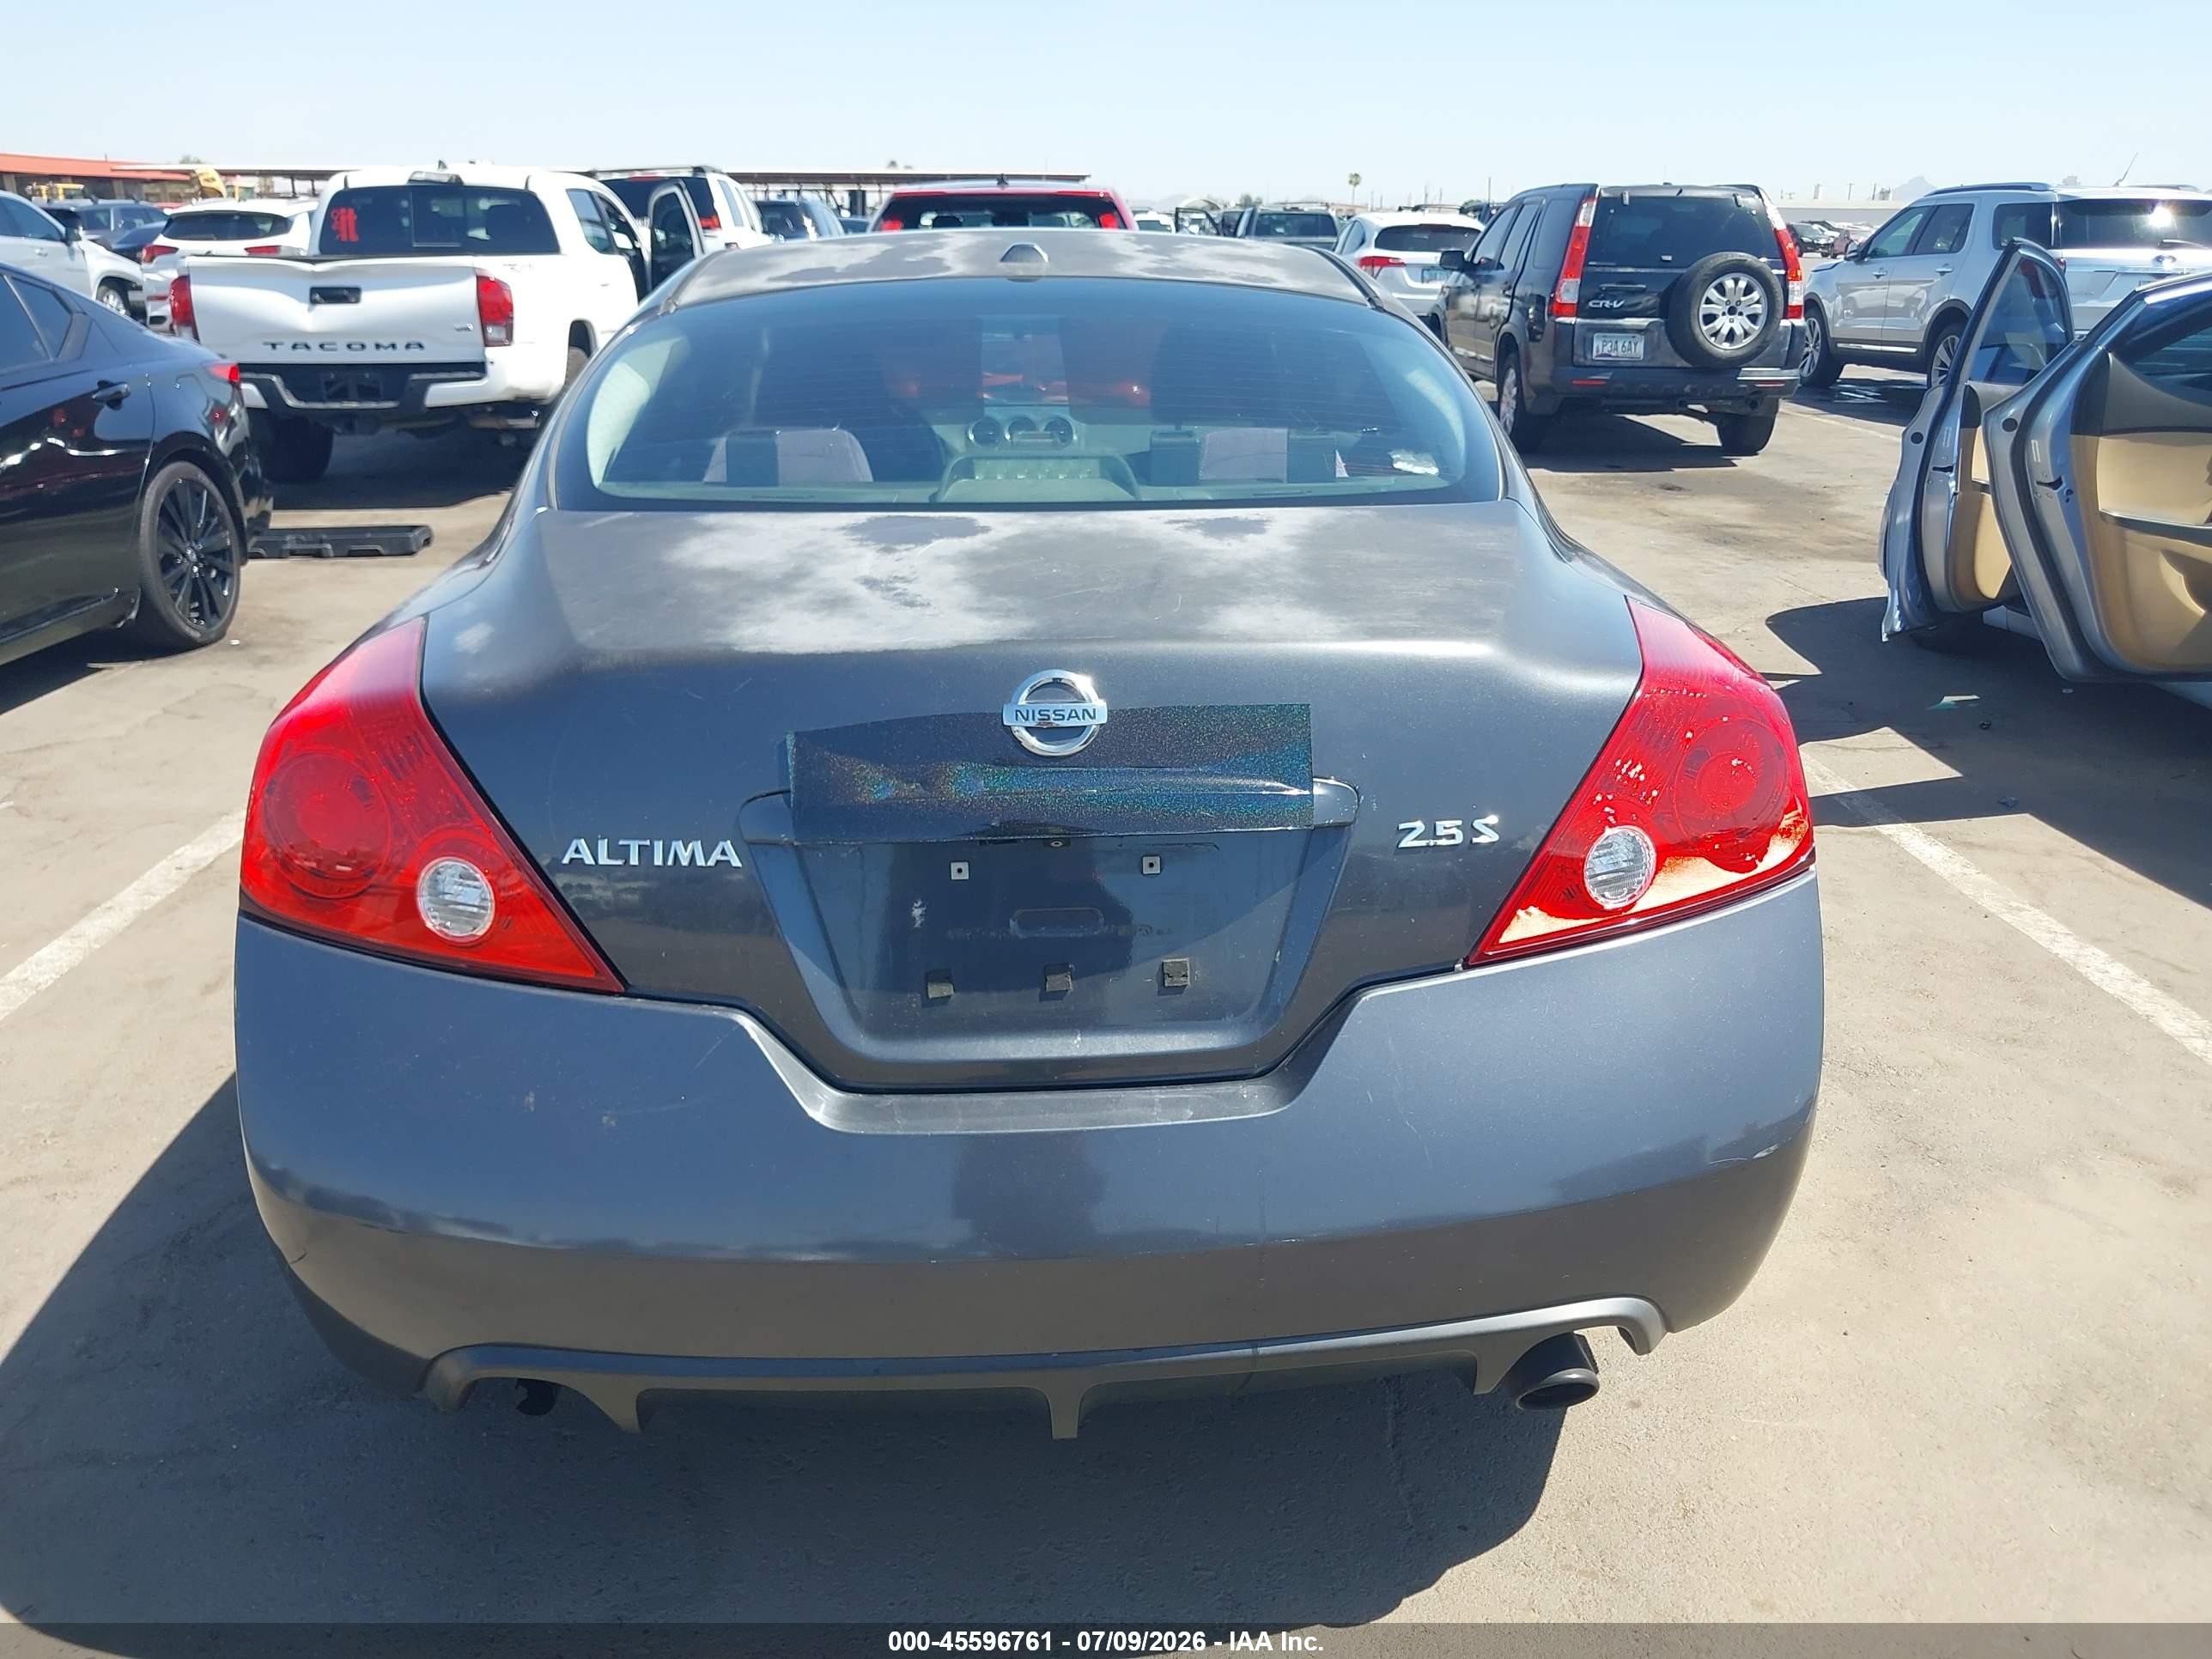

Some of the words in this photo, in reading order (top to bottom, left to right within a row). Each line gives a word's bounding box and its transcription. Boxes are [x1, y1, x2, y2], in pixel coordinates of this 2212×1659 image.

[1589, 300, 1625, 308] CR-V
[263, 341, 425, 351] TACOMA
[1015, 708, 1097, 721] NISSAN
[1472, 815, 1499, 844] S
[562, 837, 742, 867] ALTIMA
